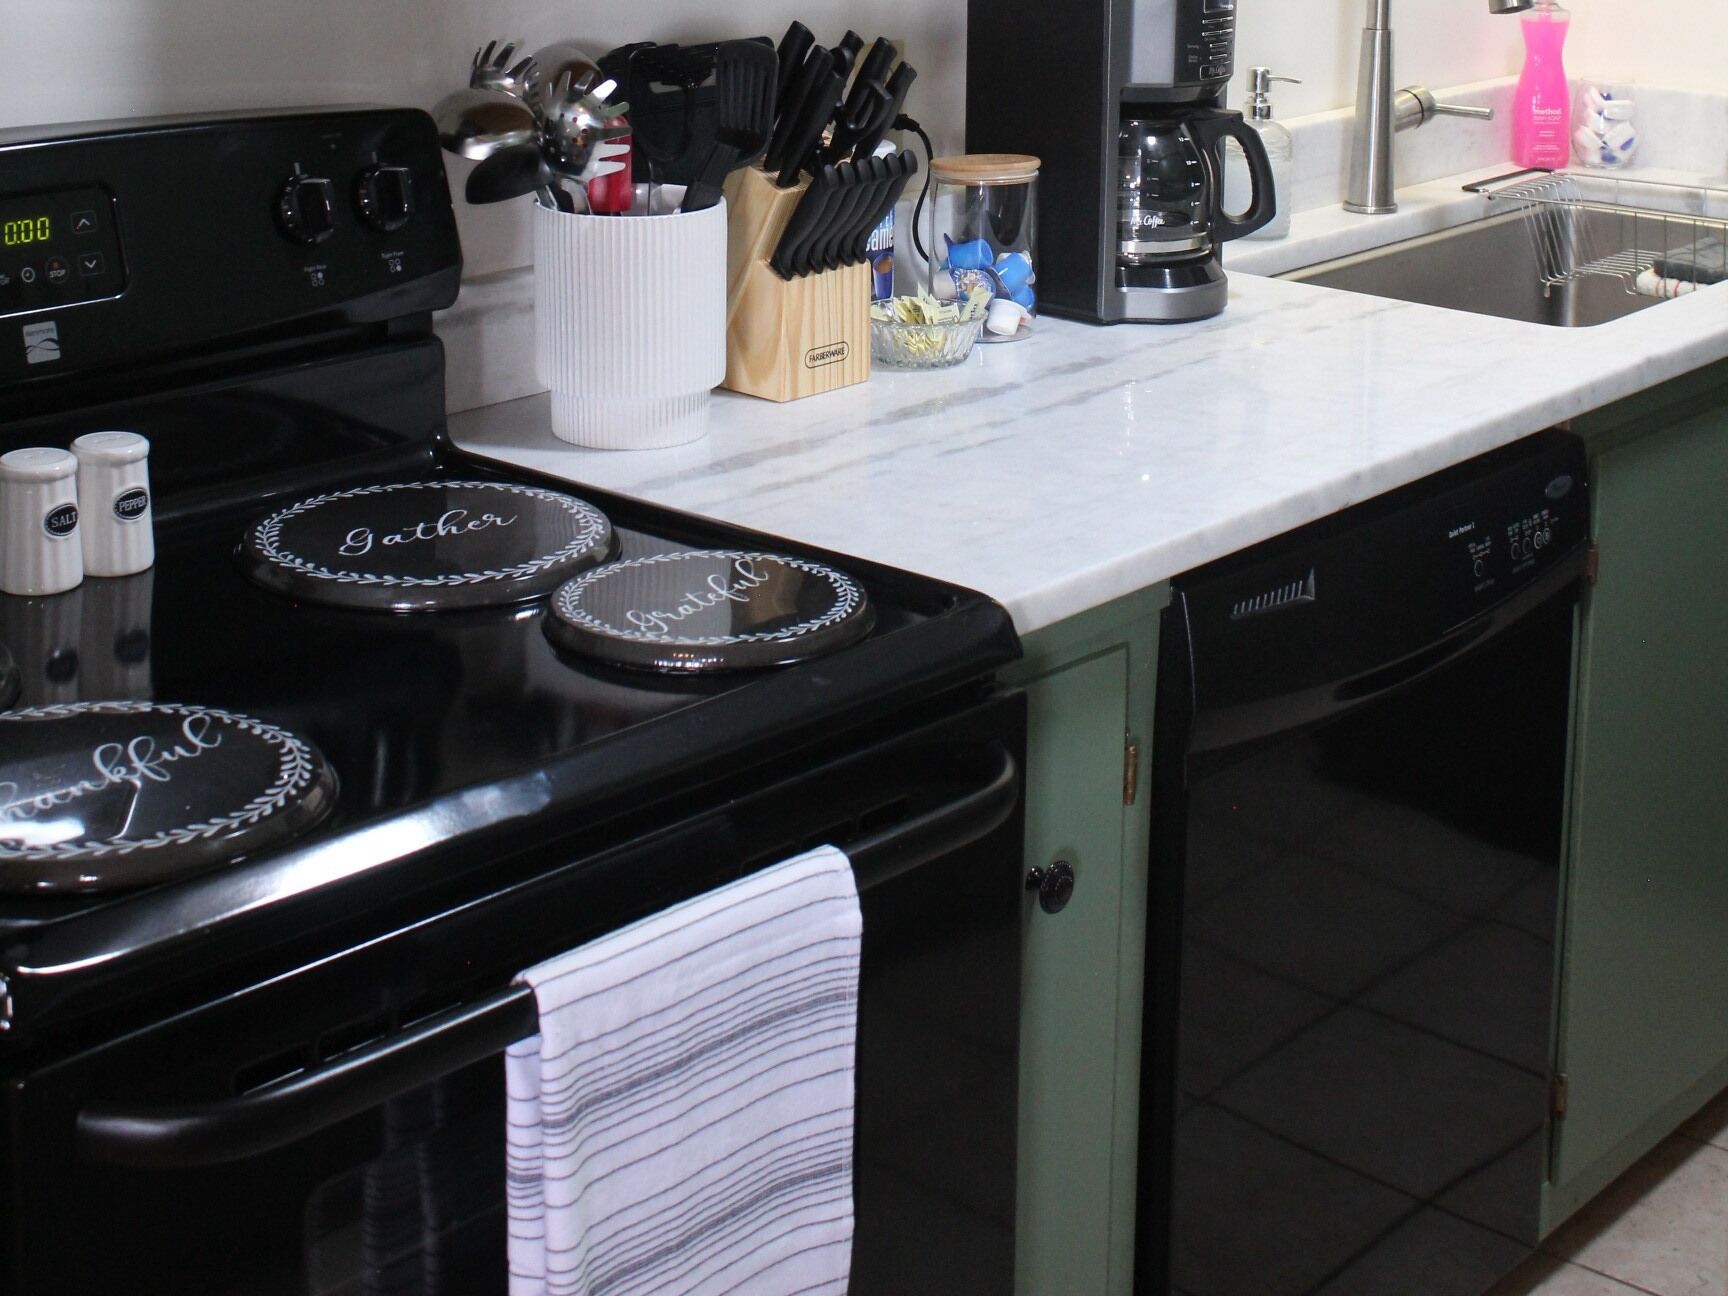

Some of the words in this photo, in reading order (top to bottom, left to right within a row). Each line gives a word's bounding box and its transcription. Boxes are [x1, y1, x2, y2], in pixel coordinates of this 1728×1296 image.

[49, 269, 66, 278] STOP
[808, 347, 845, 363] FARBERWARE
[118, 496, 146, 512] PEPPER
[51, 511, 76, 528] SALT
[338, 509, 518, 556] Gather
[626, 559, 769, 634] Grateful
[0, 714, 221, 821] hankful
